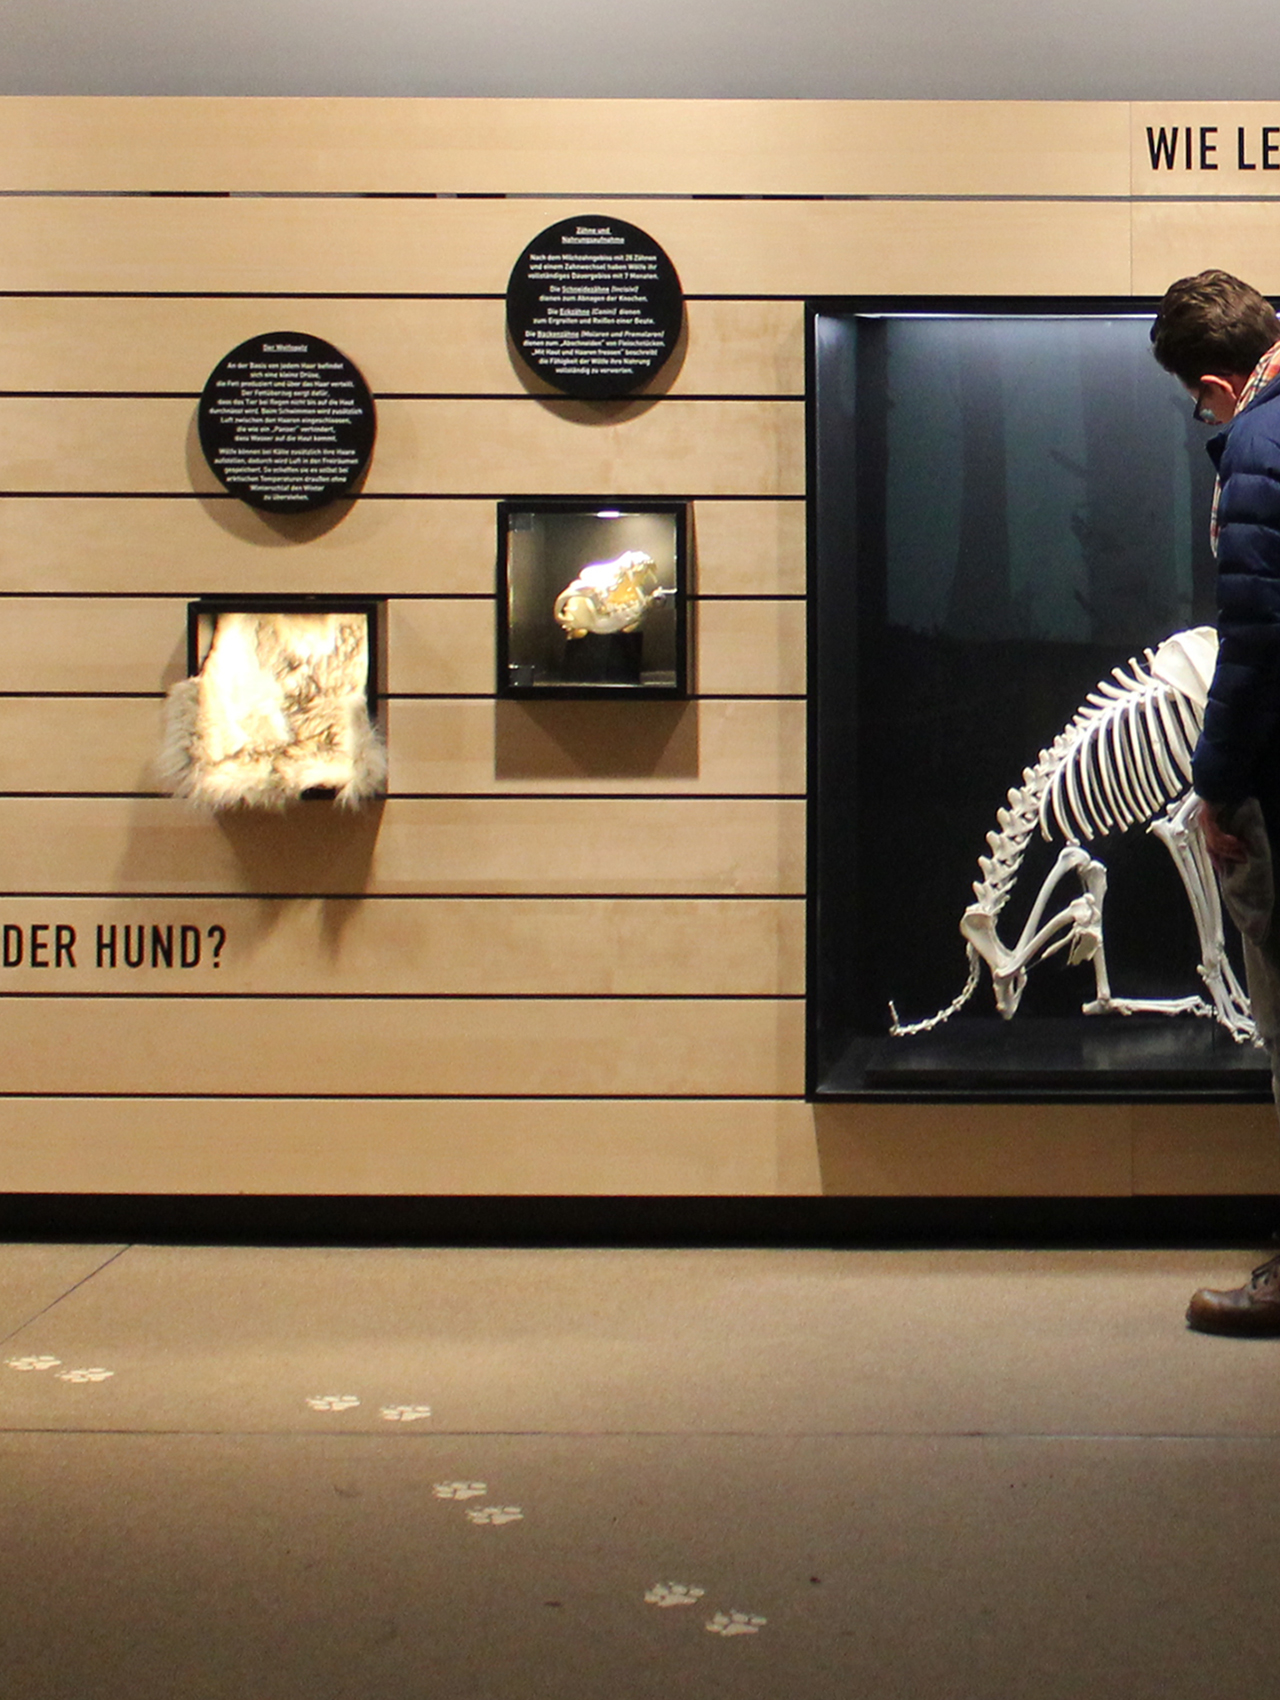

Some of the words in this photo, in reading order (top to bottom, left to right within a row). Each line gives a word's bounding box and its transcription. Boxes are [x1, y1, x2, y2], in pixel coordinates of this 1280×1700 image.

[1146, 126, 1218, 170] WIE
[3, 924, 77, 968] DER
[96, 924, 226, 968] HUND?
